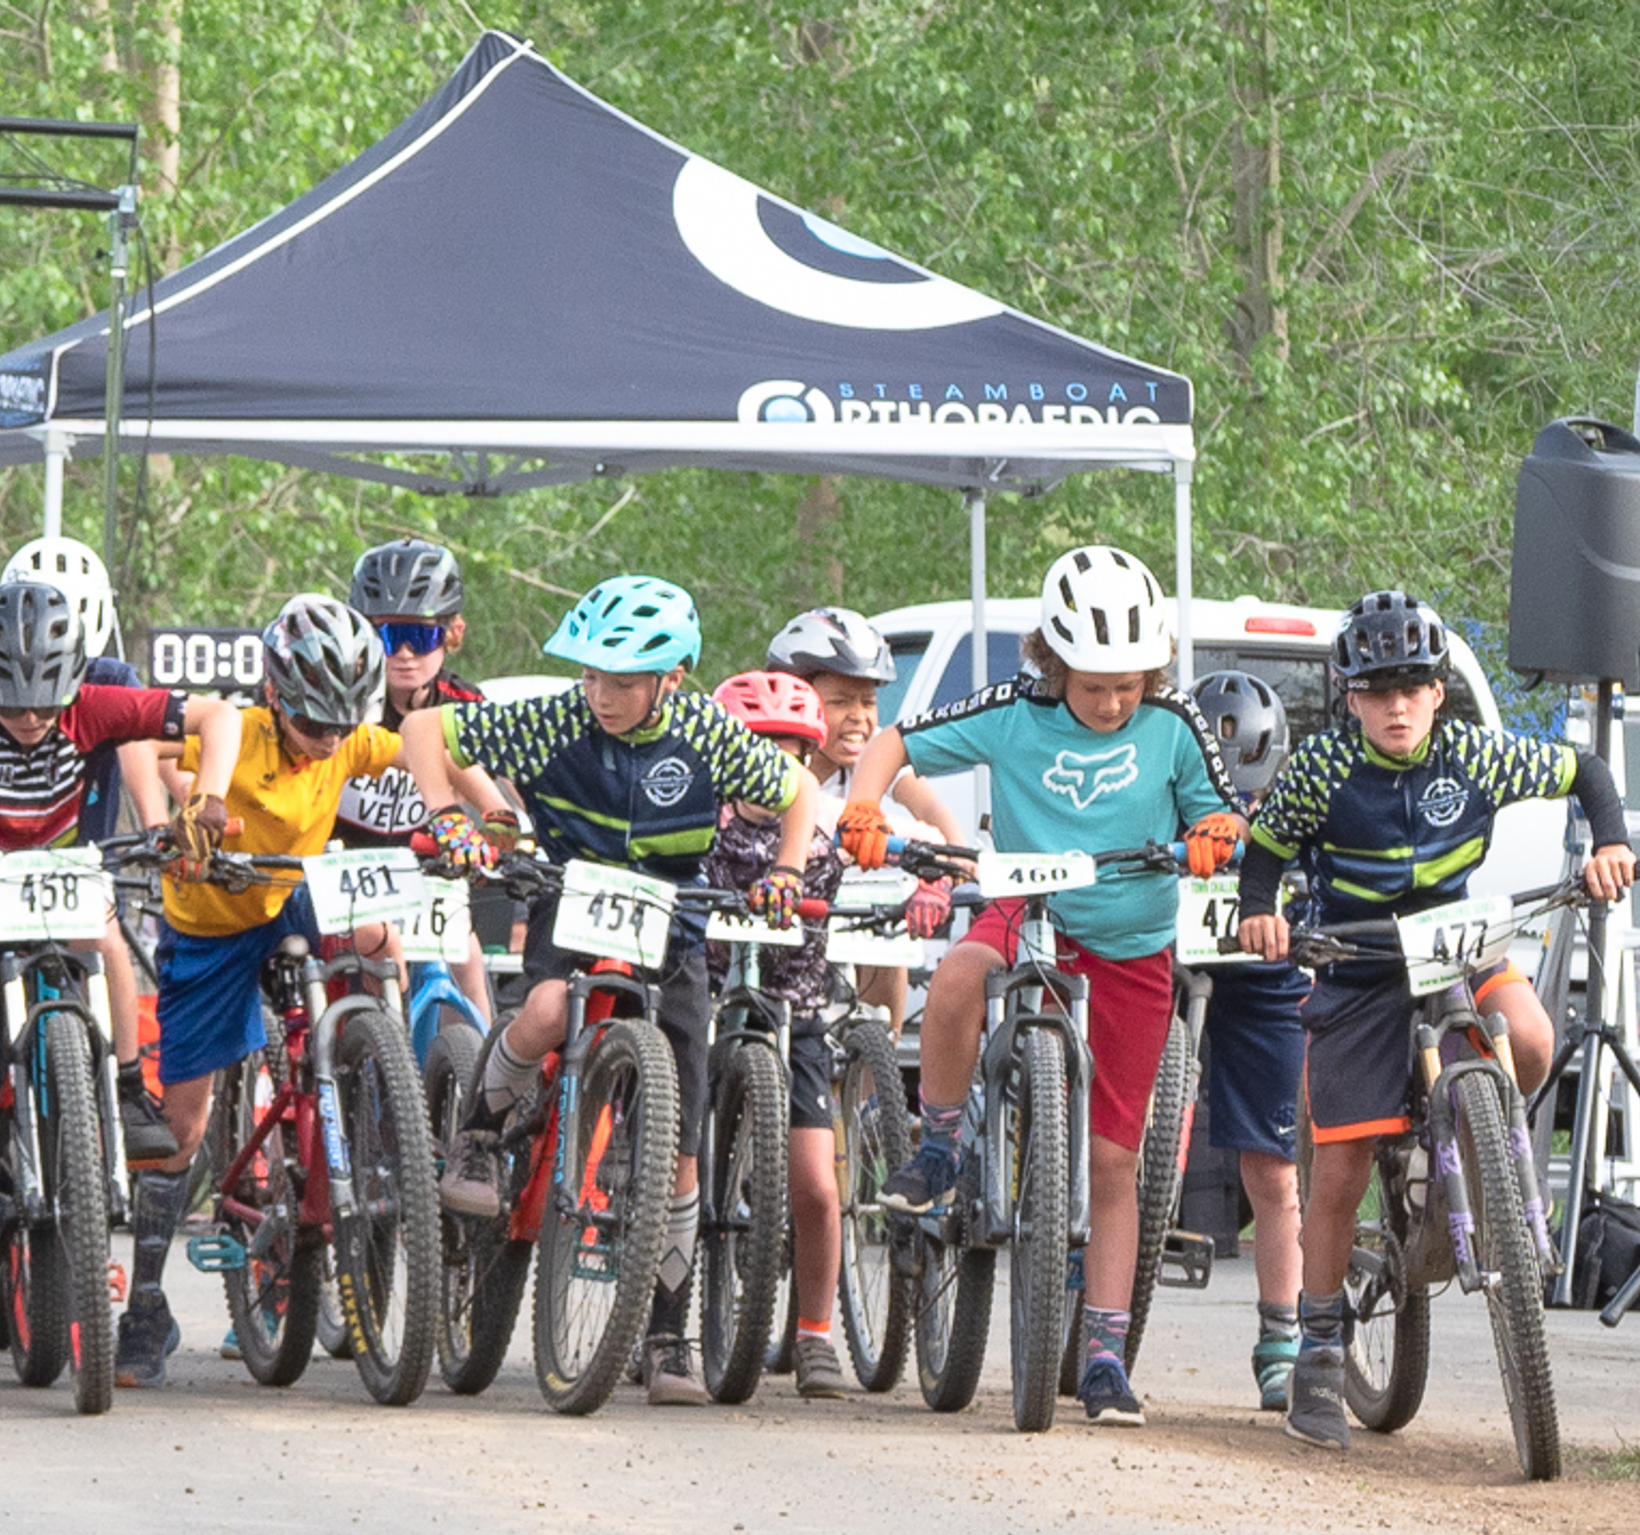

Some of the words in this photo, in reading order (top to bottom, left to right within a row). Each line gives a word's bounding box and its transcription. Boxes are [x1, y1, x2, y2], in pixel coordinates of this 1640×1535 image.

[839, 382, 1159, 402] STEAMBOAT
[153, 634, 264, 685] 00:0
[358, 798, 426, 828] VELO
[21, 872, 79, 913] 458
[340, 865, 399, 902] 461
[1009, 867, 1068, 884] 460
[587, 889, 646, 937] 454
[1202, 898, 1240, 937] 47
[1433, 919, 1488, 965] 477
